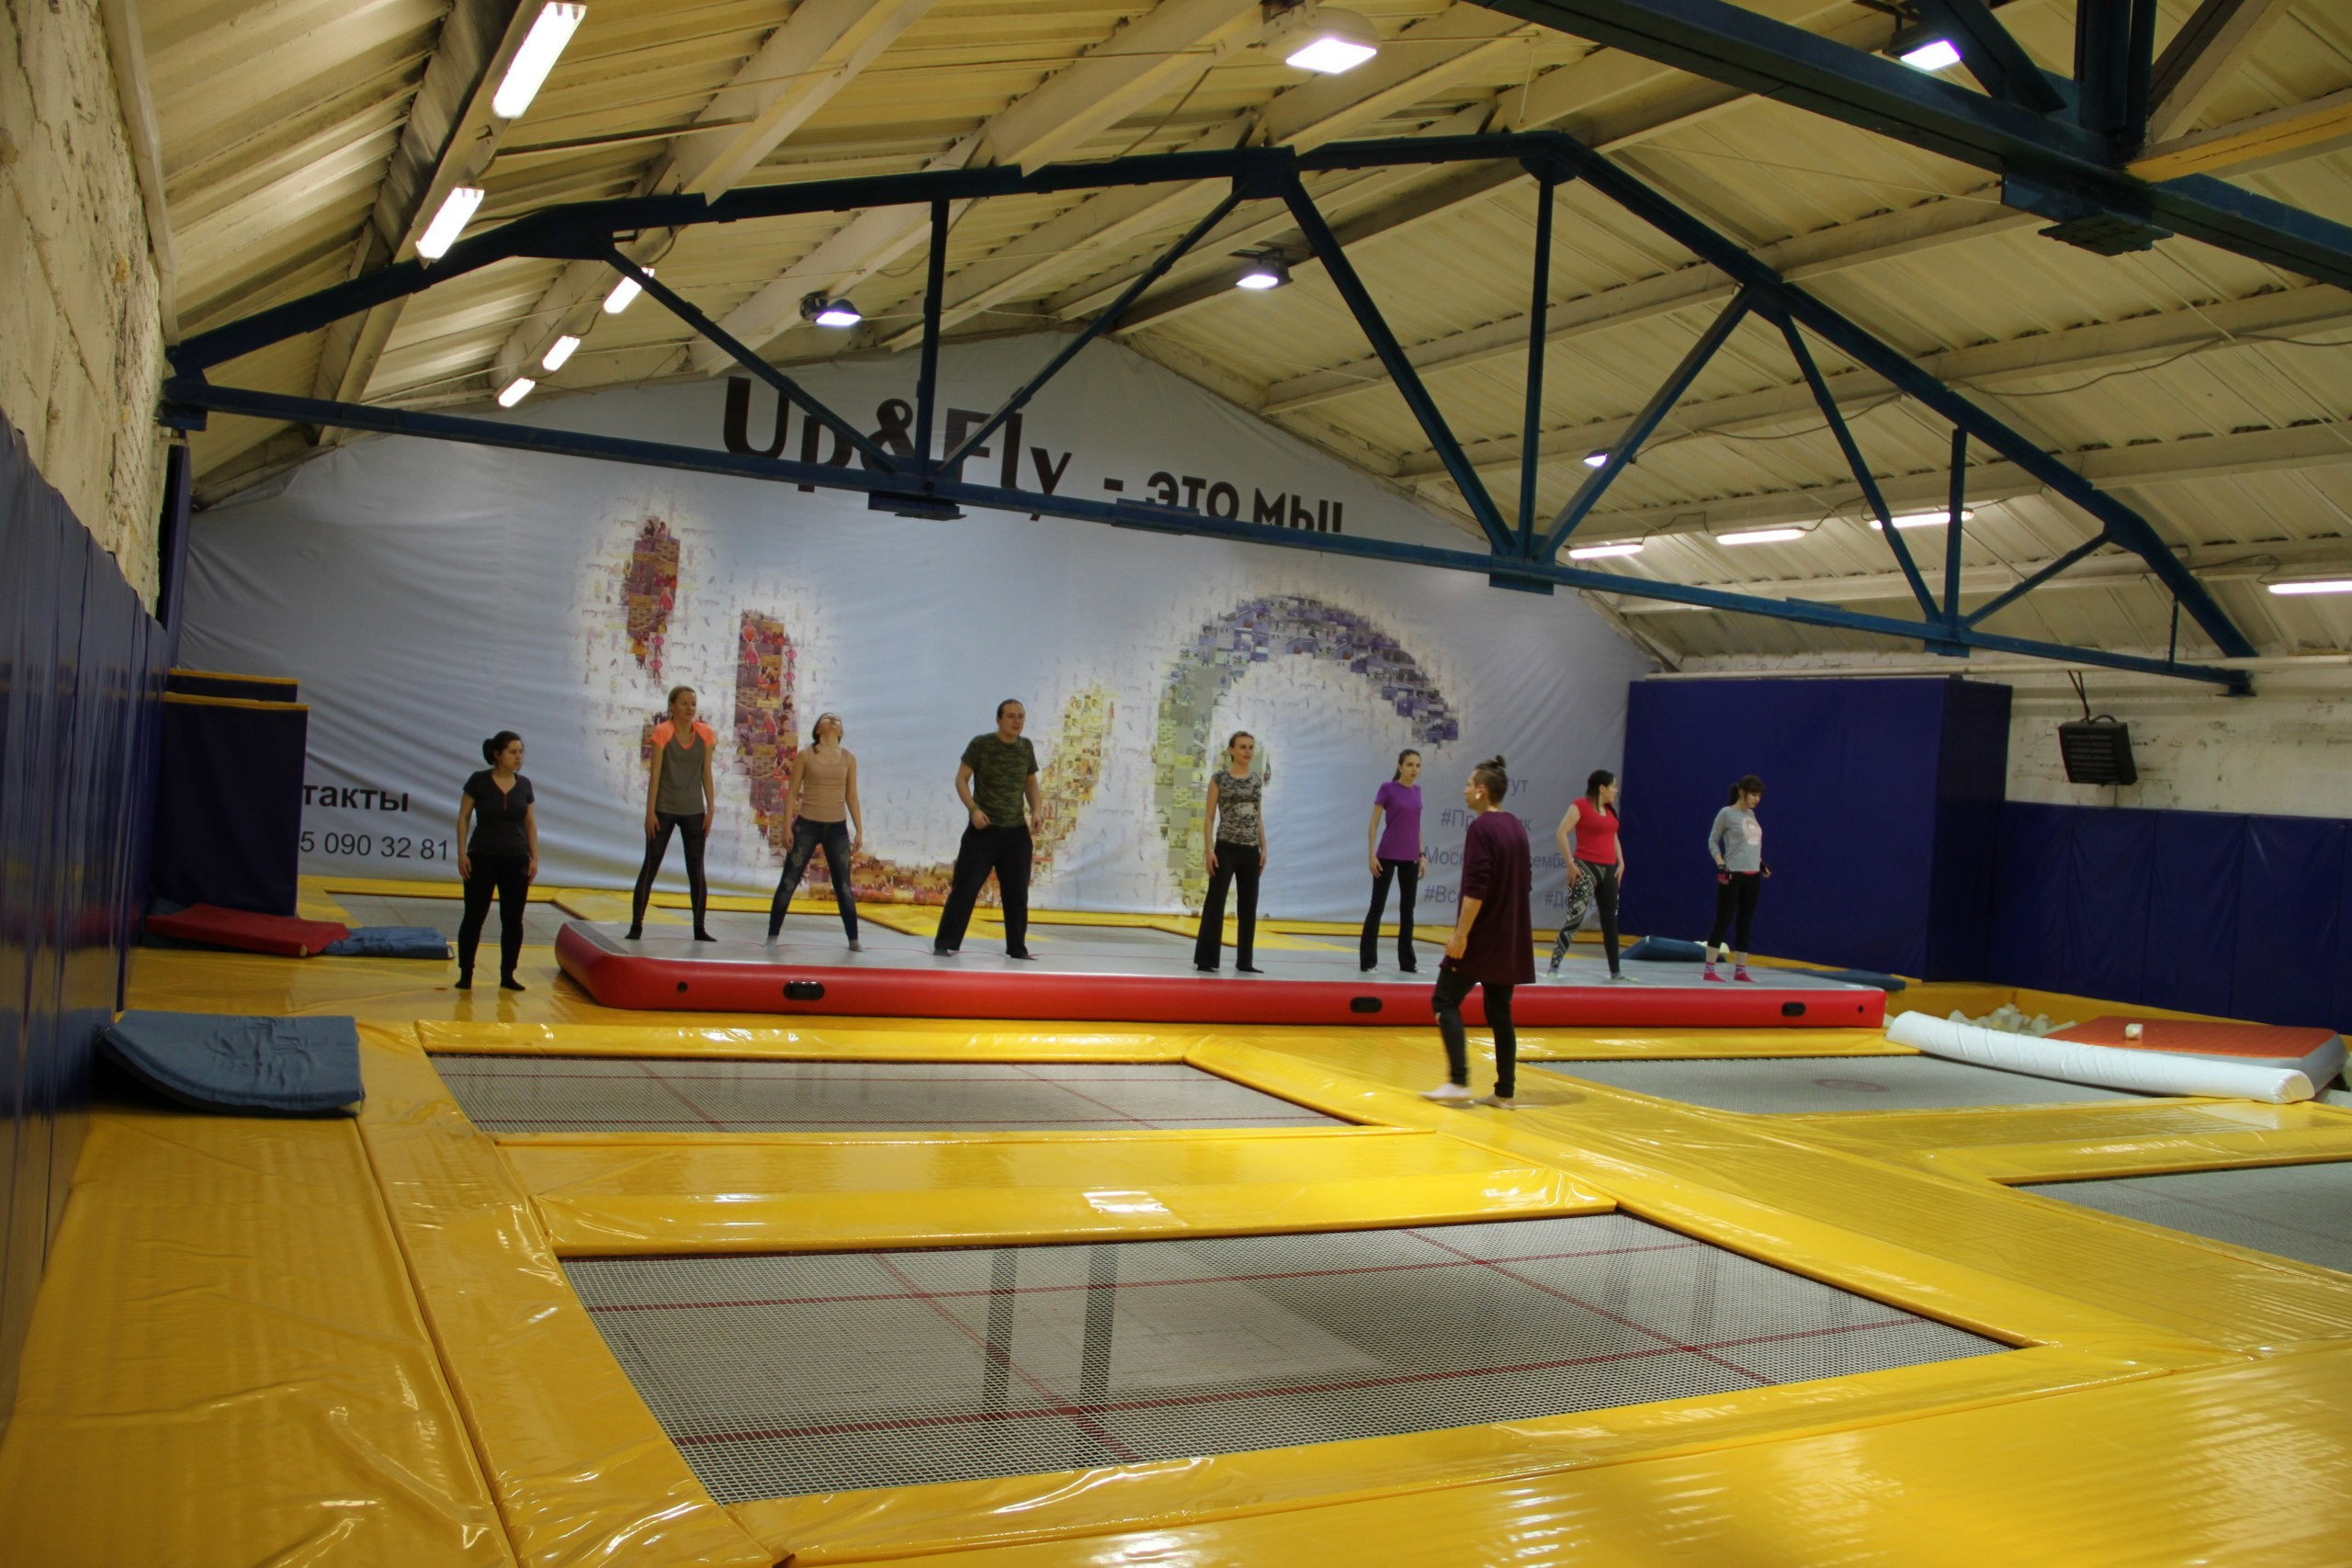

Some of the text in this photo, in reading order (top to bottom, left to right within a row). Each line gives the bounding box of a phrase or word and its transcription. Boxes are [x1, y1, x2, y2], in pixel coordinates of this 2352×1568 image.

[303, 784, 409, 812] такты
[324, 832, 371, 855] 090
[381, 836, 412, 858] 32
[420, 839, 447, 860] 81
